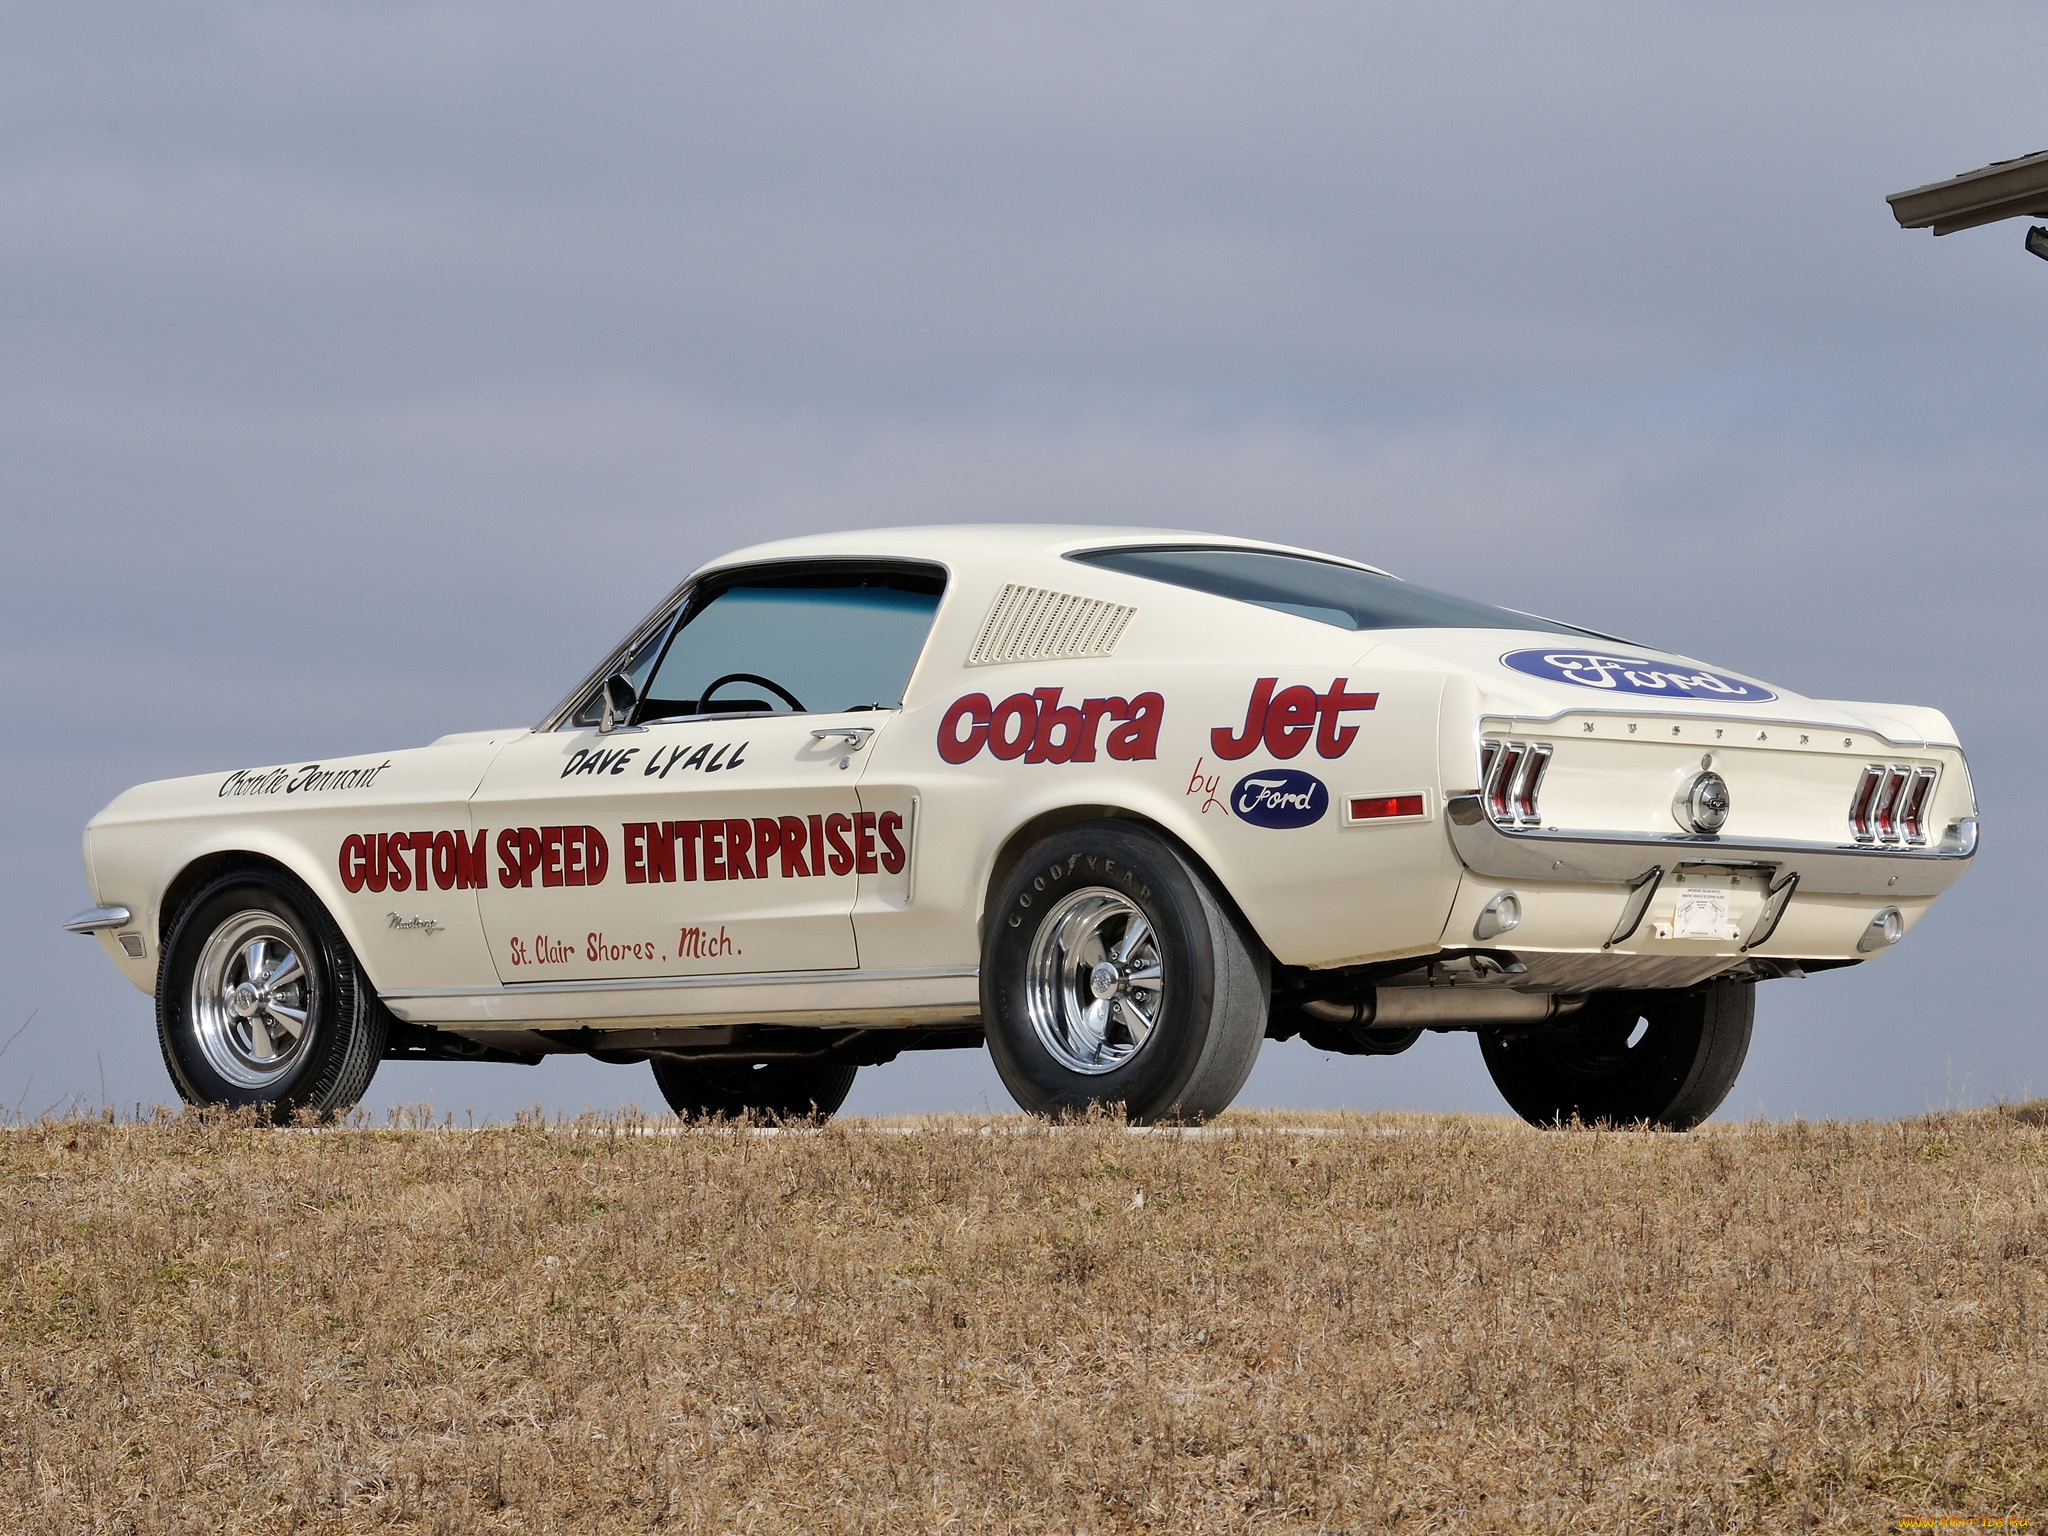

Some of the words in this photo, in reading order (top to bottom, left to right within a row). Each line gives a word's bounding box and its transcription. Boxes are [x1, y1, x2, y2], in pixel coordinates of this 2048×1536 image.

[1544, 654, 1747, 694] Ford
[1210, 676, 1380, 761] Jet
[1583, 722, 1853, 747] MUSTANG
[560, 748, 640, 779] DAVE
[644, 741, 750, 780] LYALL
[218, 768, 288, 798] Charlie
[1186, 757, 1229, 815] by
[1238, 778, 1316, 813] Ford
[339, 828, 489, 893] CUSTOM
[496, 824, 609, 889] SPEED
[621, 810, 906, 884] ENTERPRISES
[387, 911, 445, 936] Mustang
[510, 936, 532, 966] St.
[535, 934, 575, 964] Clair
[678, 925, 743, 958] Mich.
